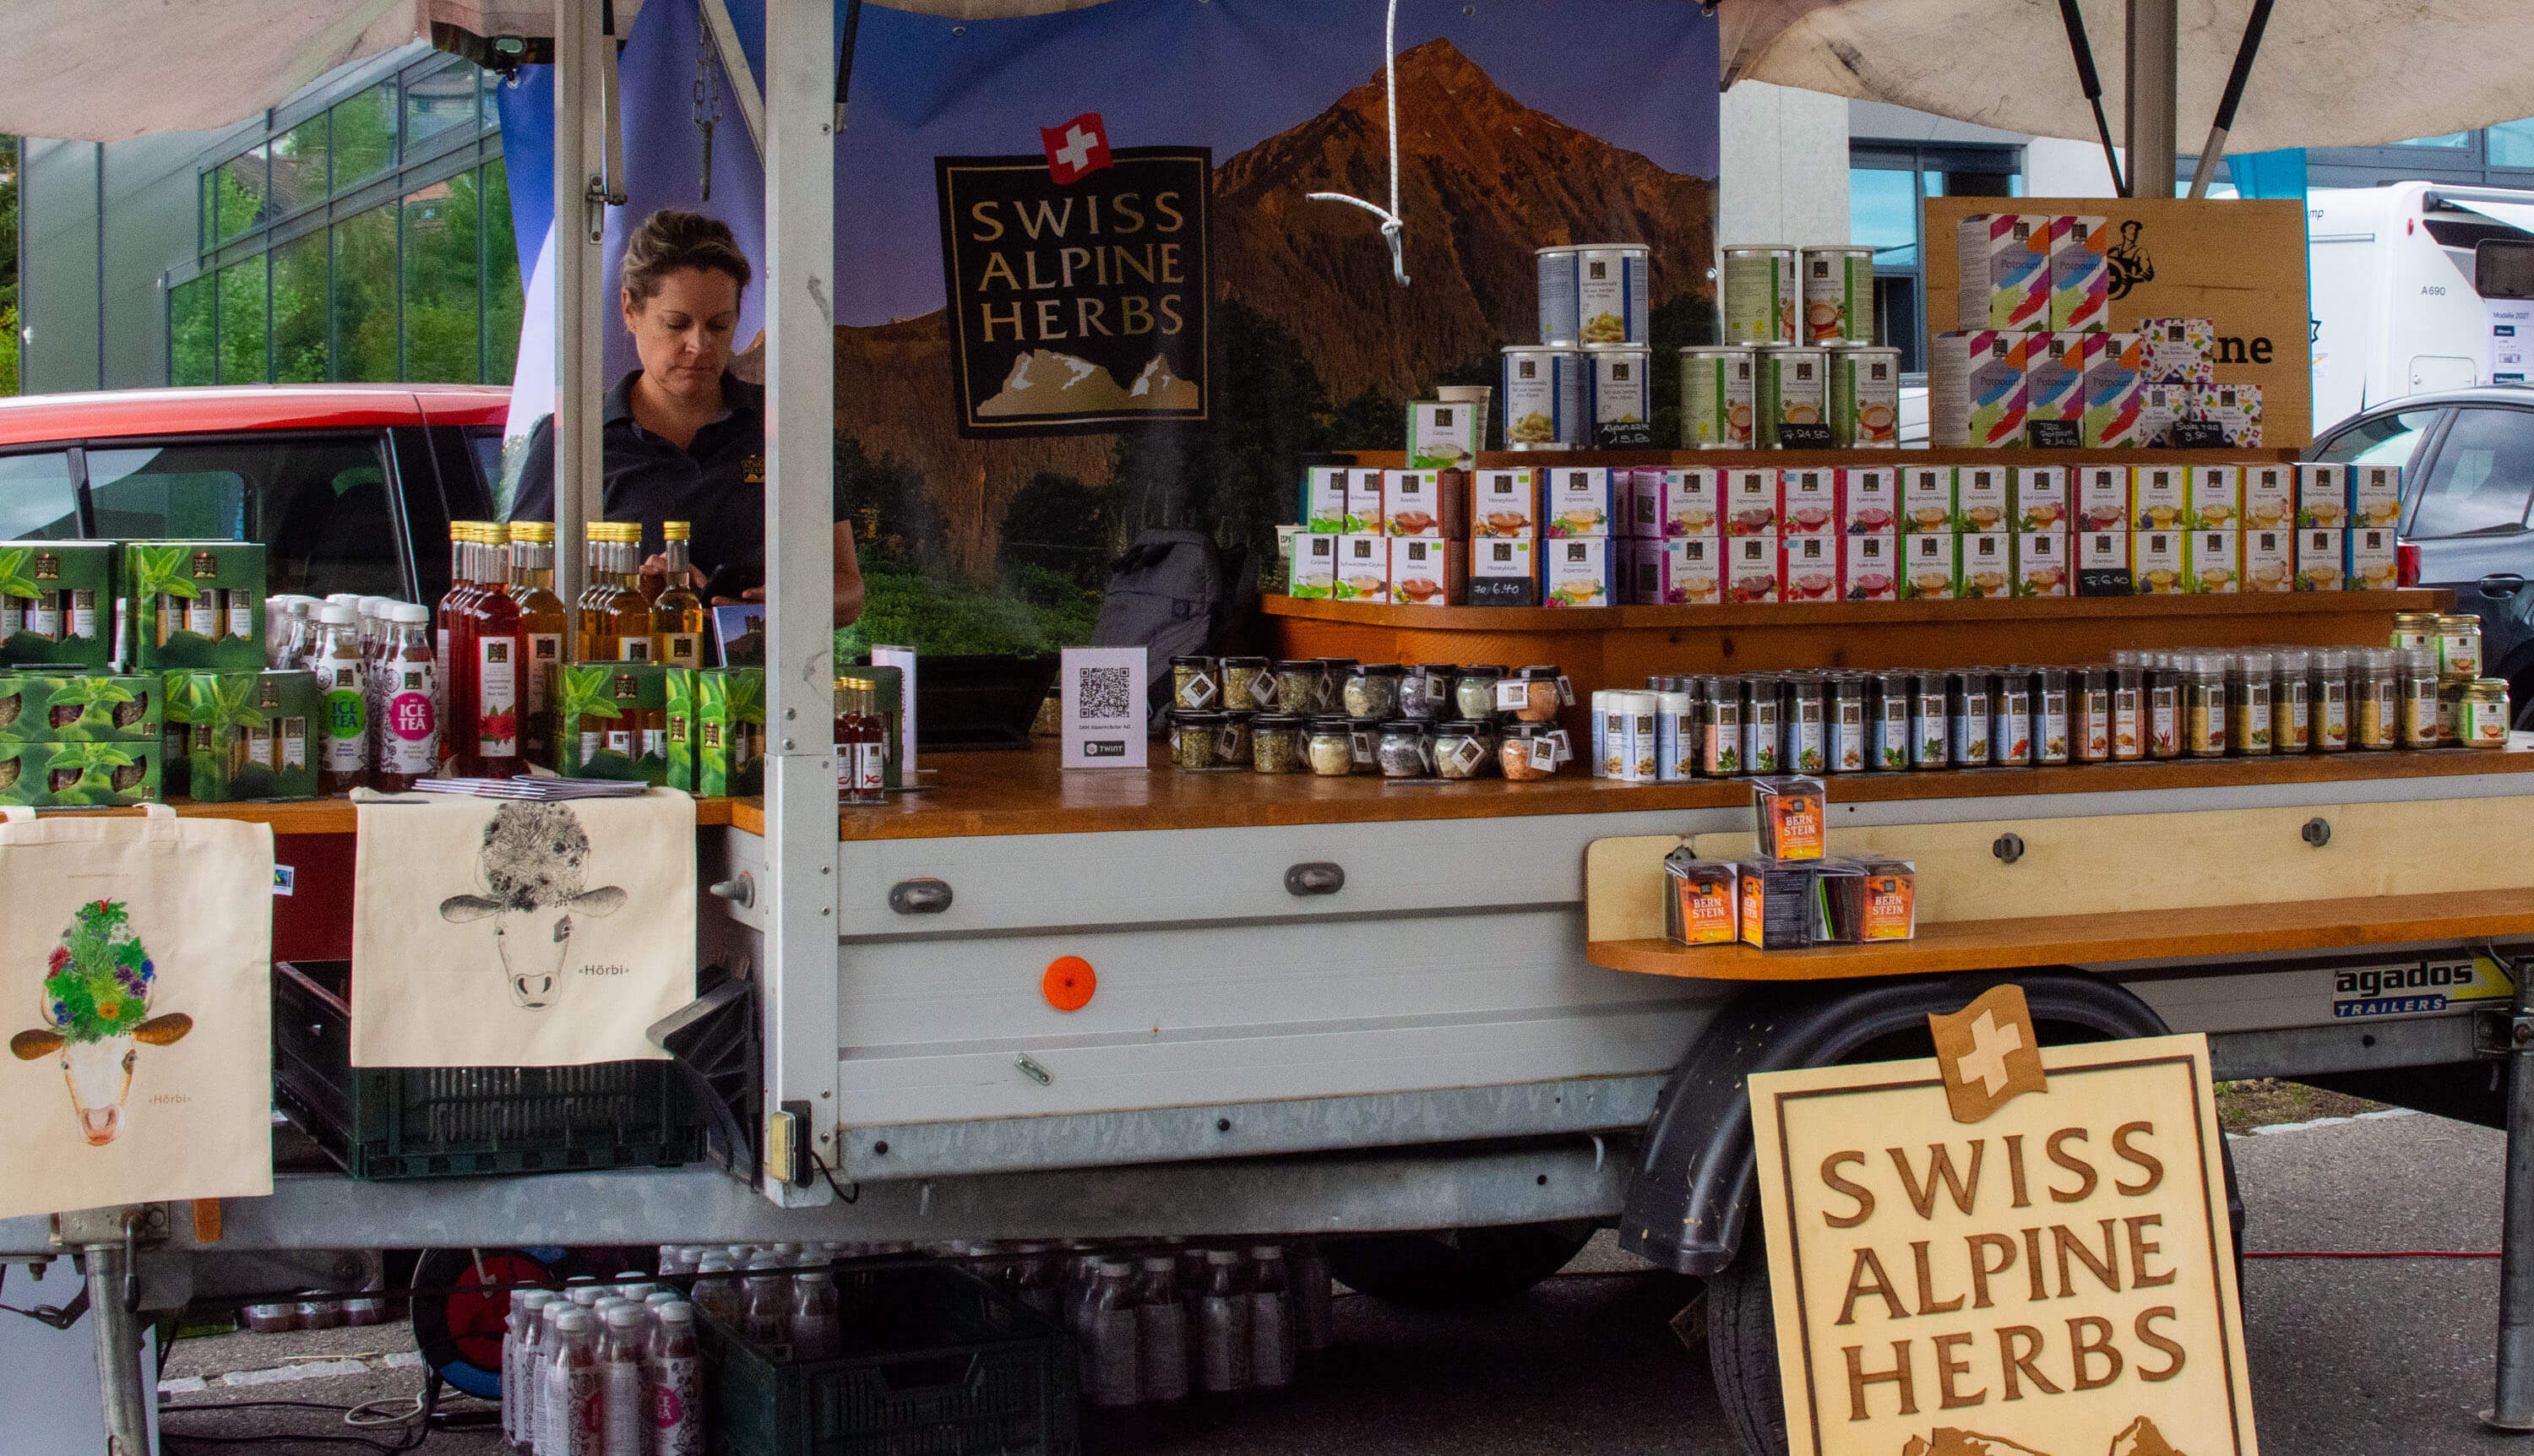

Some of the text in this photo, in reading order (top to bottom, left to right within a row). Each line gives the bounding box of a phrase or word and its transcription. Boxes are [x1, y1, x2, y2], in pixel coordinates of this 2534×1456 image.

[971, 192, 1183, 242] SWISS
[978, 243, 1184, 291] ALPINE
[2001, 258, 2042, 270] Potpourri
[2059, 260, 2100, 271] Potpourri
[2421, 286, 2445, 296] A 690
[981, 294, 1183, 342] HERBS
[2101, 574, 2129, 585] 6.40
[1493, 582, 1520, 595] 6.40
[331, 701, 357, 715] ICE
[400, 704, 427, 718] ICE
[331, 714, 358, 728] TEA
[398, 717, 427, 731] TEA
[1786, 815, 1813, 826] BERN
[1783, 824, 1815, 837] STEIN
[1693, 898, 1721, 909] BERN
[1875, 895, 1901, 905] BERN
[1692, 907, 1724, 920] STEIN
[1872, 905, 1903, 915] STEIN
[2336, 961, 2474, 997] agados
[2337, 999, 2443, 1017] TRAILERS
[1820, 1122, 2164, 1228] SWISS
[1835, 1214, 2177, 1326] ALPINE
[1841, 1306, 2186, 1421] HERBS
